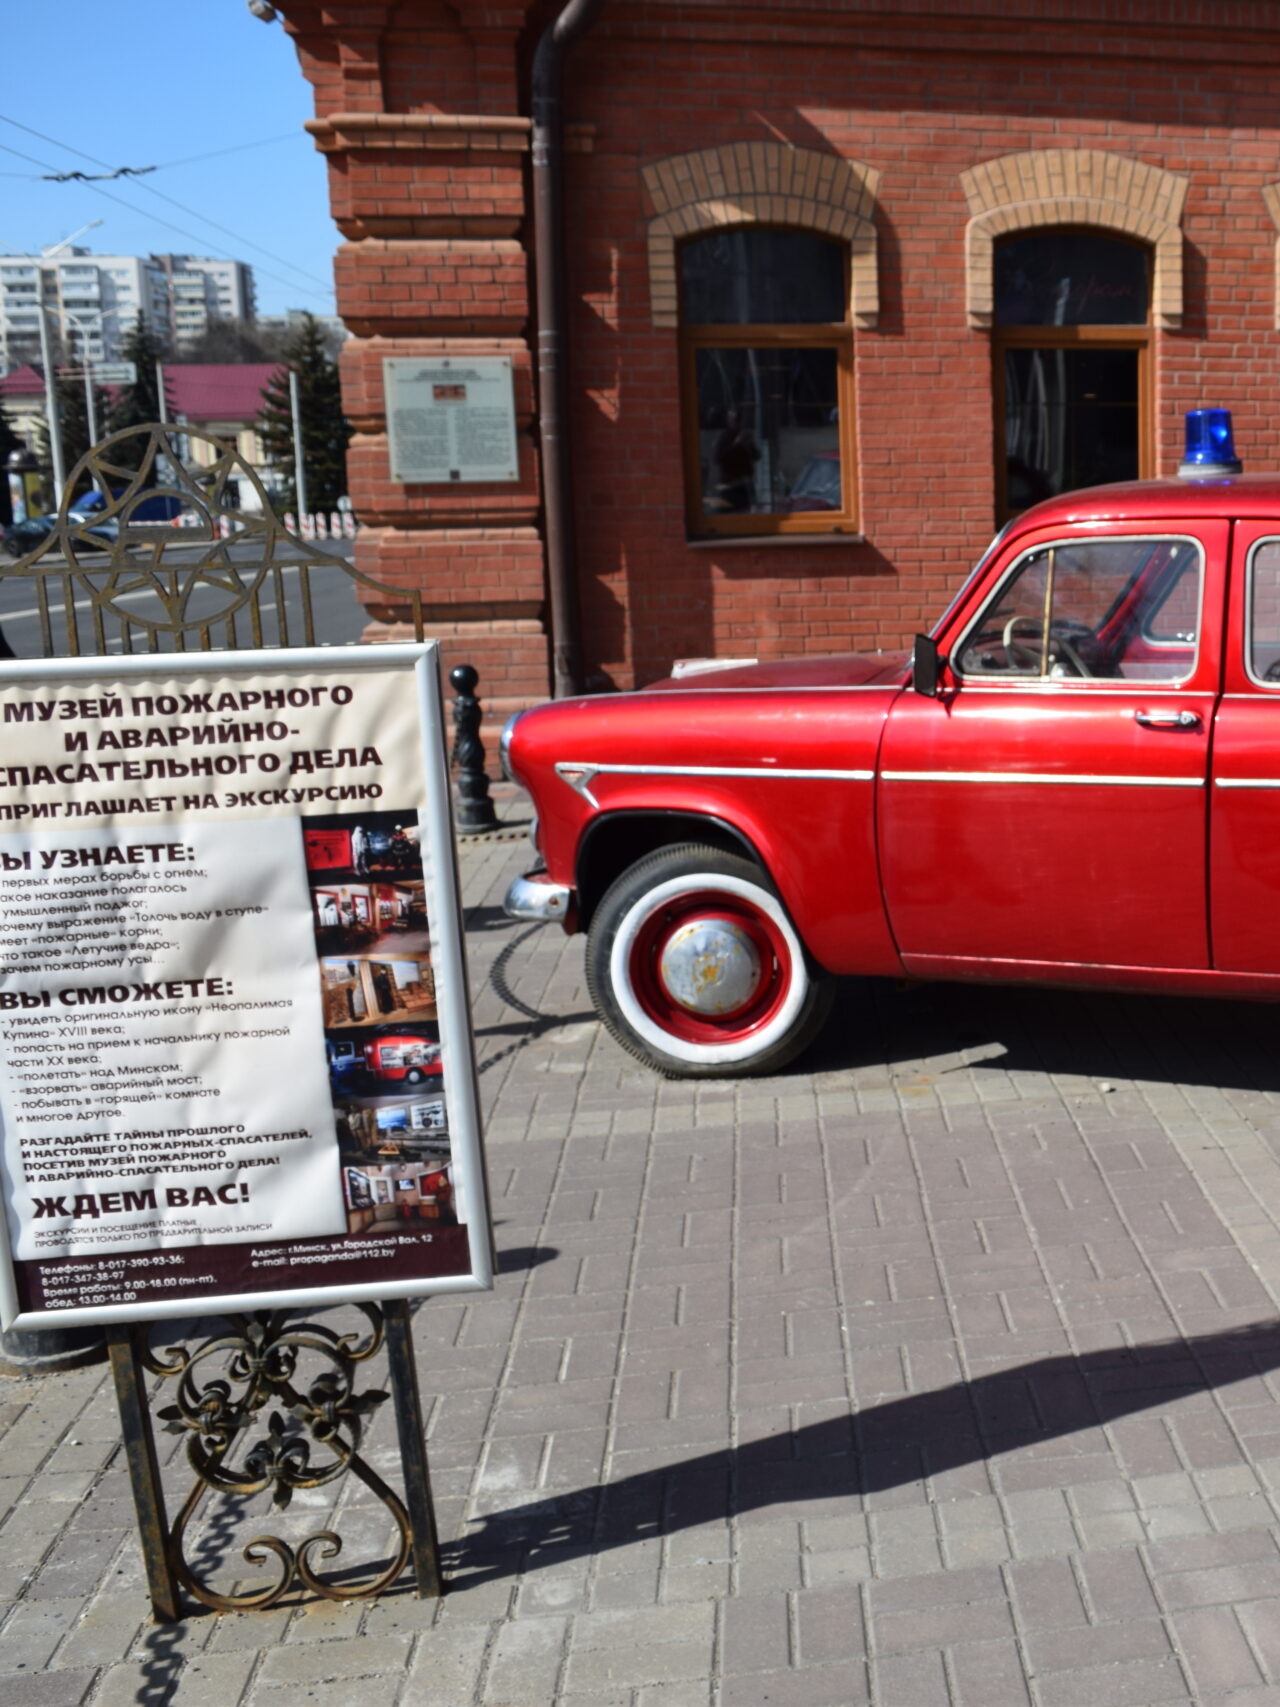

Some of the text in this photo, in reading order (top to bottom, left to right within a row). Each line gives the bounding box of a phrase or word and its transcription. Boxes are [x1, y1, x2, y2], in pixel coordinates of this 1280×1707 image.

[4, 685, 354, 723] МУЗЕЙ ПОЖАРНОГО
[64, 718, 300, 752] И АВАРИЙНО-
[289, 746, 383, 775] ДЕЛА
[0, 783, 383, 820] ПРИГЛАШАЕТ НА ЭКСКУРСИЮ
[0, 843, 195, 871] Ы УЗНАЕТЕ:
[2, 869, 208, 889] первых мерах борьбы с огнем;
[0, 885, 187, 902] акое наказание полагалось
[2, 899, 148, 918] умышленный поджог;
[0, 921, 43, 932] очему
[47, 915, 127, 930] выражение
[180, 910, 212, 921] воду
[215, 909, 222, 917] в
[0, 936, 28, 946] меет
[119, 927, 163, 938] корни;
[21, 948, 62, 960] такое
[0, 964, 41, 975] зачем
[44, 958, 124, 971] пожарному
[0, 977, 234, 1010] ВЫ СМОЖЕТЕ:
[9, 1015, 61, 1028] увидеть
[64, 1008, 160, 1024] оригинальную
[163, 1005, 202, 1016] икону
[13, 1043, 65, 1053] попасть
[68, 1042, 84, 1051] на
[87, 1039, 130, 1051] прием
[133, 1038, 141, 1046] к
[144, 1033, 221, 1045] начальнику
[224, 1026, 290, 1039] пожарной
[58, 1026, 87, 1037] XVIII
[91, 1025, 126, 1035] века;
[7, 1058, 44, 1067] части
[67, 1055, 102, 1065] века;
[90, 1068, 115, 1078] над
[117, 1063, 183, 1075] Минском;
[90, 1078, 163, 1091] аварийный
[167, 1076, 203, 1086] мост;
[21, 1098, 82, 1109] побывать
[85, 1097, 92, 1105] в
[165, 1088, 221, 1100] комнате
[26, 1112, 73, 1122] многое
[20, 1124, 245, 1147] РАЗГАДАЙТЕ ТАЙНЫ ПРОШЛОГО
[21, 1150, 31, 1159] И
[34, 1144, 127, 1158] НАСТОЯЩЕГО
[23, 1150, 227, 1171] ПОСЕТИВ МУЗЕЙ ПОЖАРНОГО
[25, 1157, 280, 1183] И АВАРИЙНО-СПАСАТЕЛЬНОГО ДЕЛА!
[31, 1182, 250, 1219] ЖДЕМ ВАС!
[34, 1227, 89, 1238] ЭКСКУРСИИ
[91, 1226, 98, 1234] И
[100, 1220, 157, 1232] ПОСЕЩЕНИЕ
[96, 1233, 131, 1242] ТОЛЬКО
[133, 1232, 147, 1240] ПО
[235, 1223, 273, 1232] ЗАПИСИ
[251, 1247, 287, 1258] Адрес:
[421, 1234, 433, 1243] 12
[39, 1263, 96, 1275] Телефоны:
[251, 1256, 288, 1268] e-mail:
[41, 1271, 125, 1286] 8-017-347-38-97
[43, 1288, 78, 1298] Время
[80, 1283, 123, 1294] работы:
[45, 1299, 77, 1308] обед:
